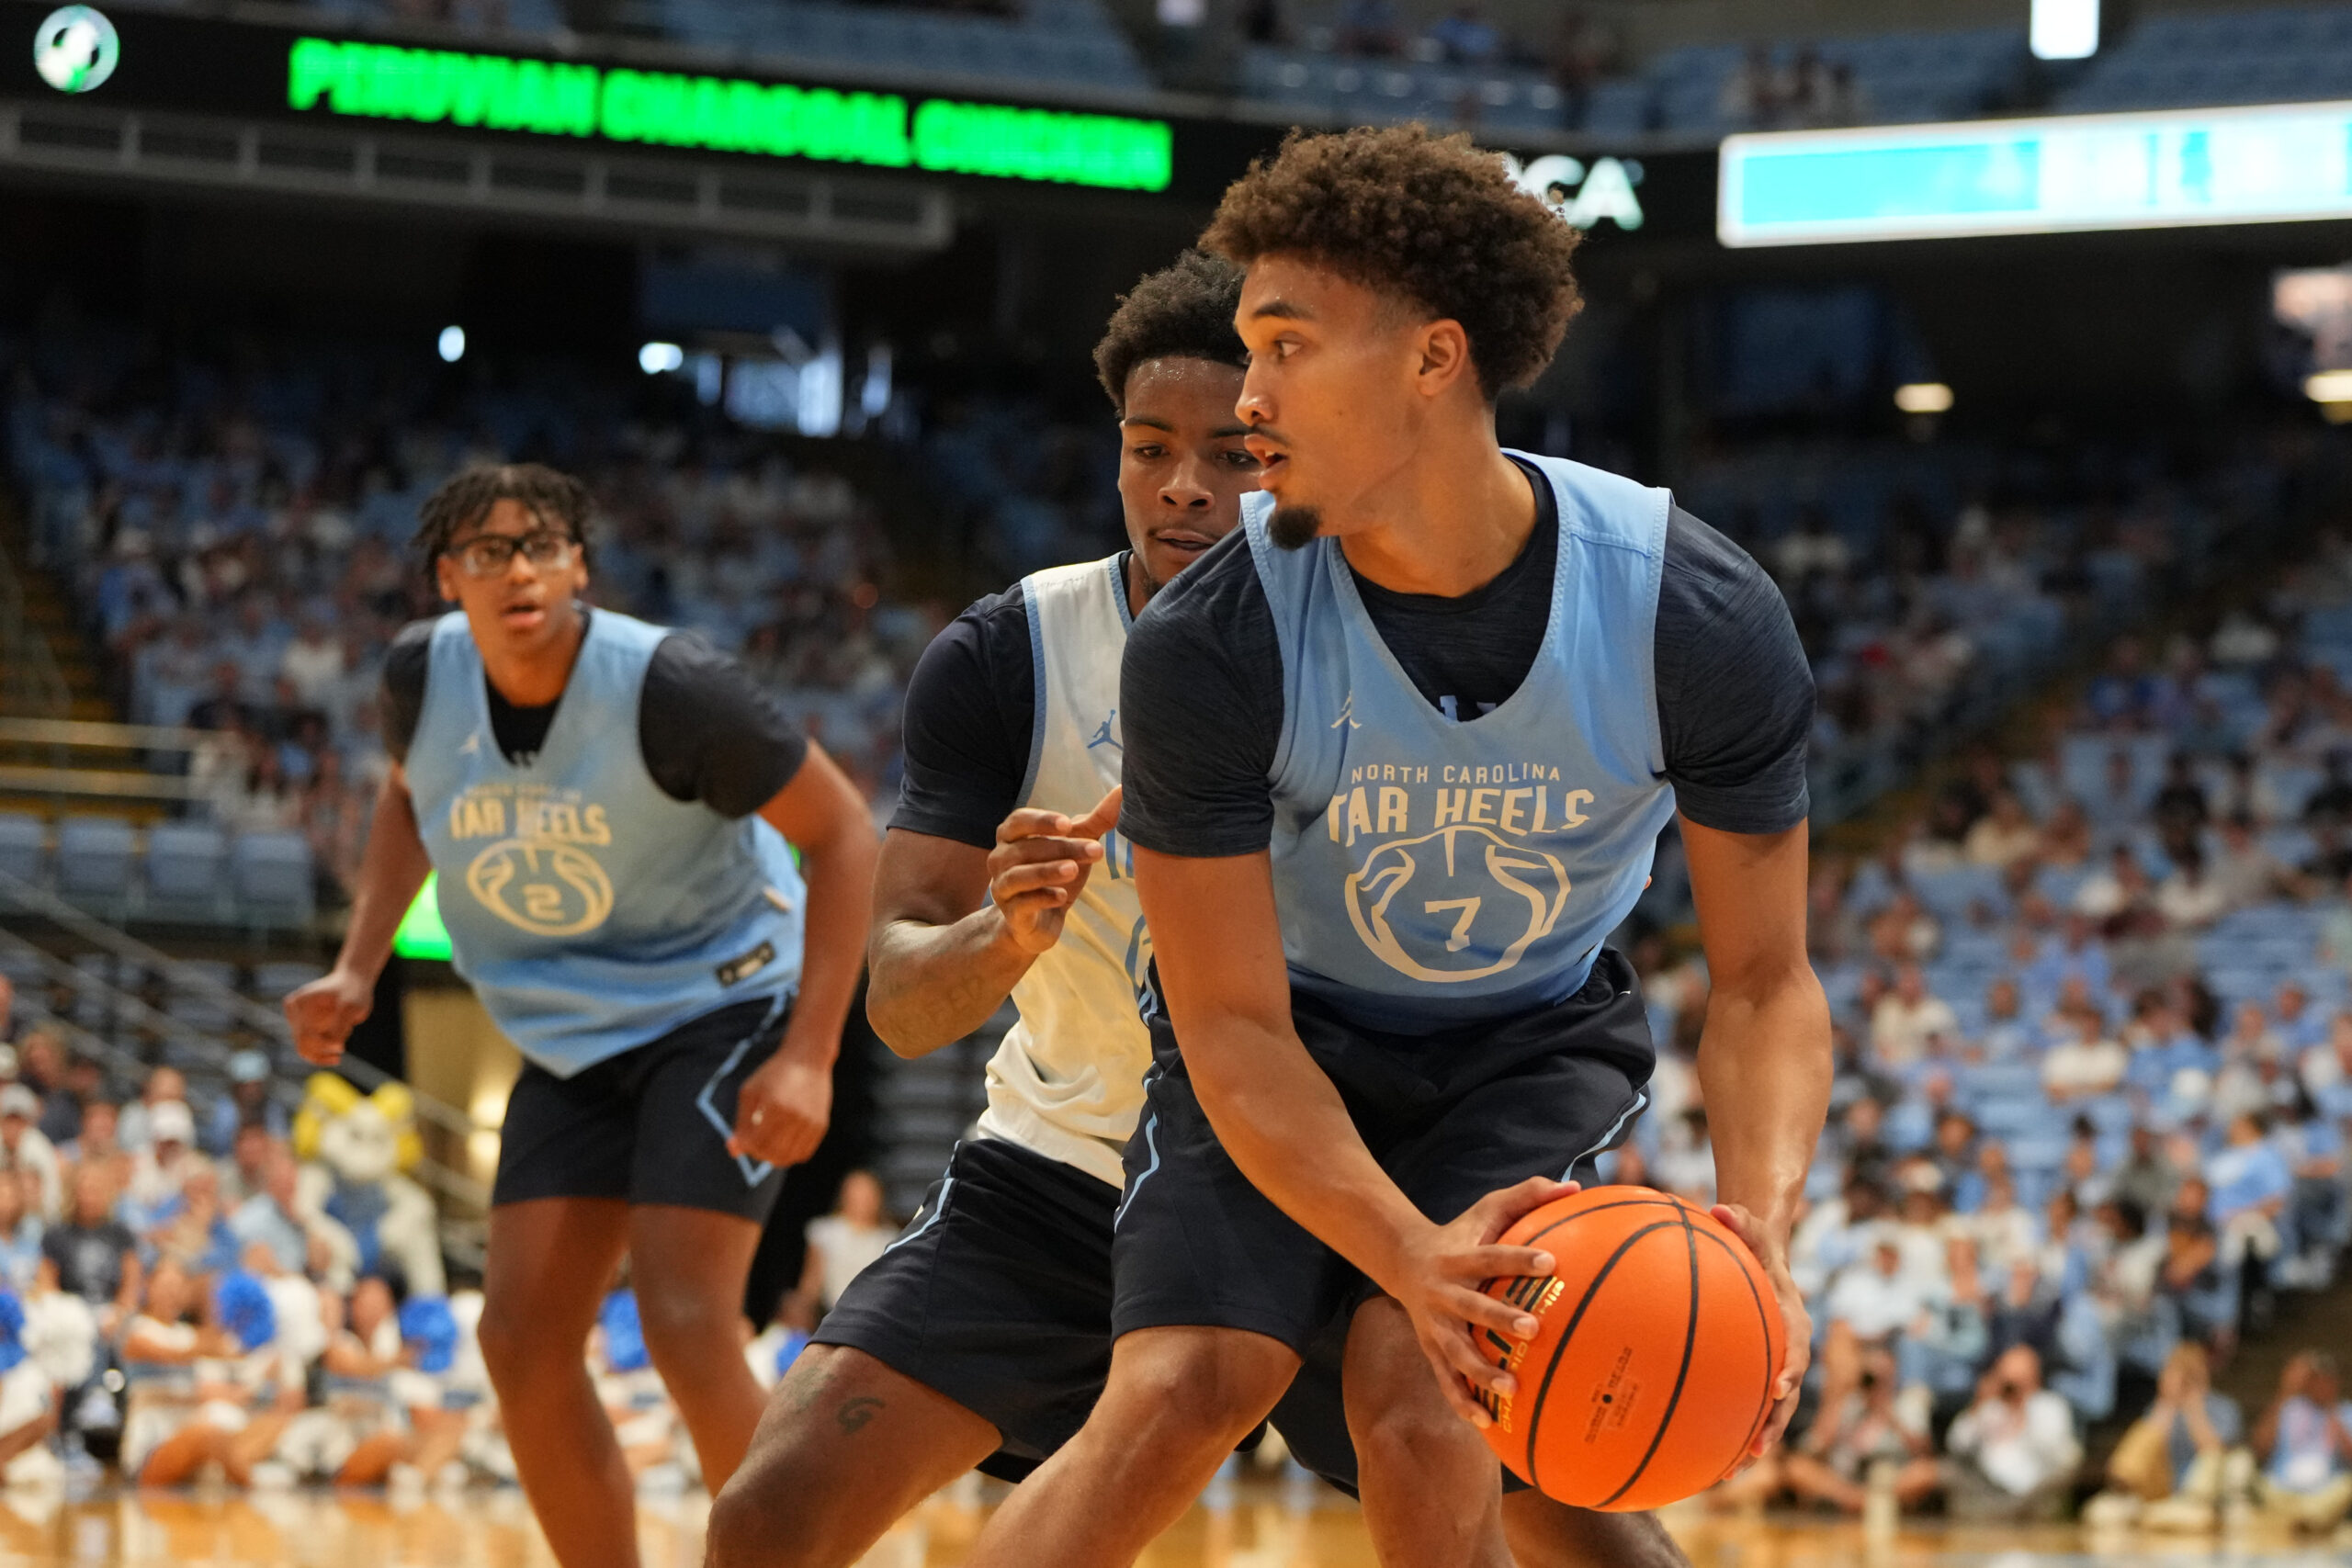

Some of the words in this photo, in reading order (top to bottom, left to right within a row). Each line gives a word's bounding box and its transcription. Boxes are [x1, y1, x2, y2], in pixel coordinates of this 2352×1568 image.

[1351, 763, 1429, 784] NORTH
[1442, 761, 1561, 784] CAROLINA
[1328, 786, 1409, 847] TAR
[1433, 785, 1595, 837] HEELS
[1424, 897, 1481, 953] 7
